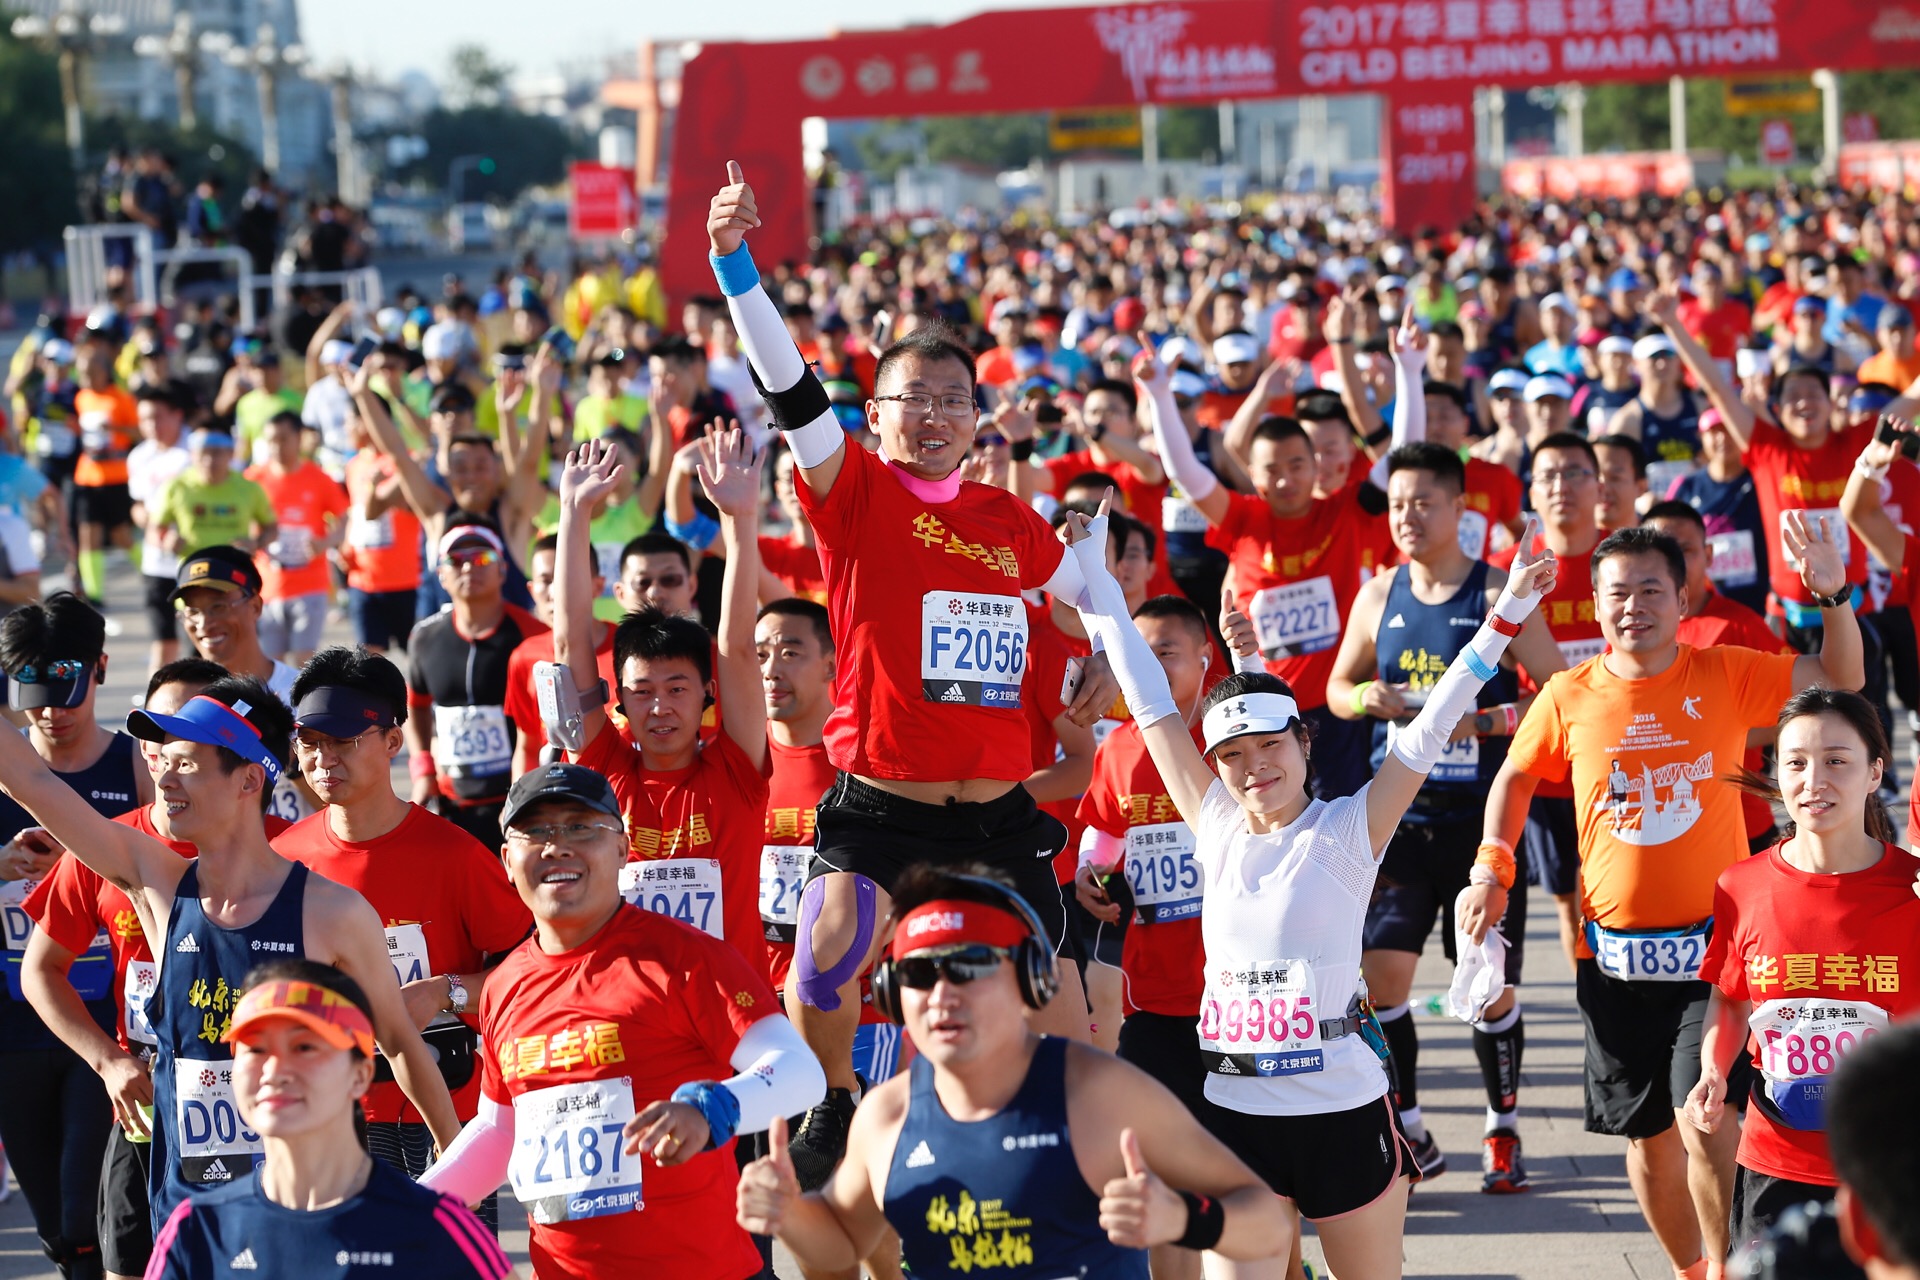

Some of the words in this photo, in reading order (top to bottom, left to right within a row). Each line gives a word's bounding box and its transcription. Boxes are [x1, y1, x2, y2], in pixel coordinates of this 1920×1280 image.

[1300, 49, 1397, 86] CFLD
[1402, 40, 1550, 80] BEIJING
[1561, 27, 1779, 72] MARATHON
[966, 601, 1014, 618] 华夏幸福
[1259, 601, 1330, 640] F2227
[930, 625, 1024, 674] F2056
[940, 694, 966, 702] adidas
[1633, 713, 1656, 723] 2016
[1624, 743, 1661, 751] International
[1135, 830, 1177, 846] 华夏幸福
[643, 866, 696, 881] 华夏幸福
[262, 942, 295, 953] 华夏幸福
[1601, 938, 1701, 975] E1832
[1236, 969, 1288, 986] 华夏幸福
[1750, 952, 1900, 993] 华夏幸福
[1201, 996, 1315, 1043] D9985
[1798, 1005, 1858, 1022] 华夏幸福
[500, 1022, 626, 1084] 华夏幸福
[1218, 1066, 1241, 1074] adidas
[1279, 1056, 1321, 1070] 北京现代
[515, 1121, 627, 1187] 2187
[203, 1170, 232, 1180] adidas
[595, 1190, 640, 1209] 北京现代
